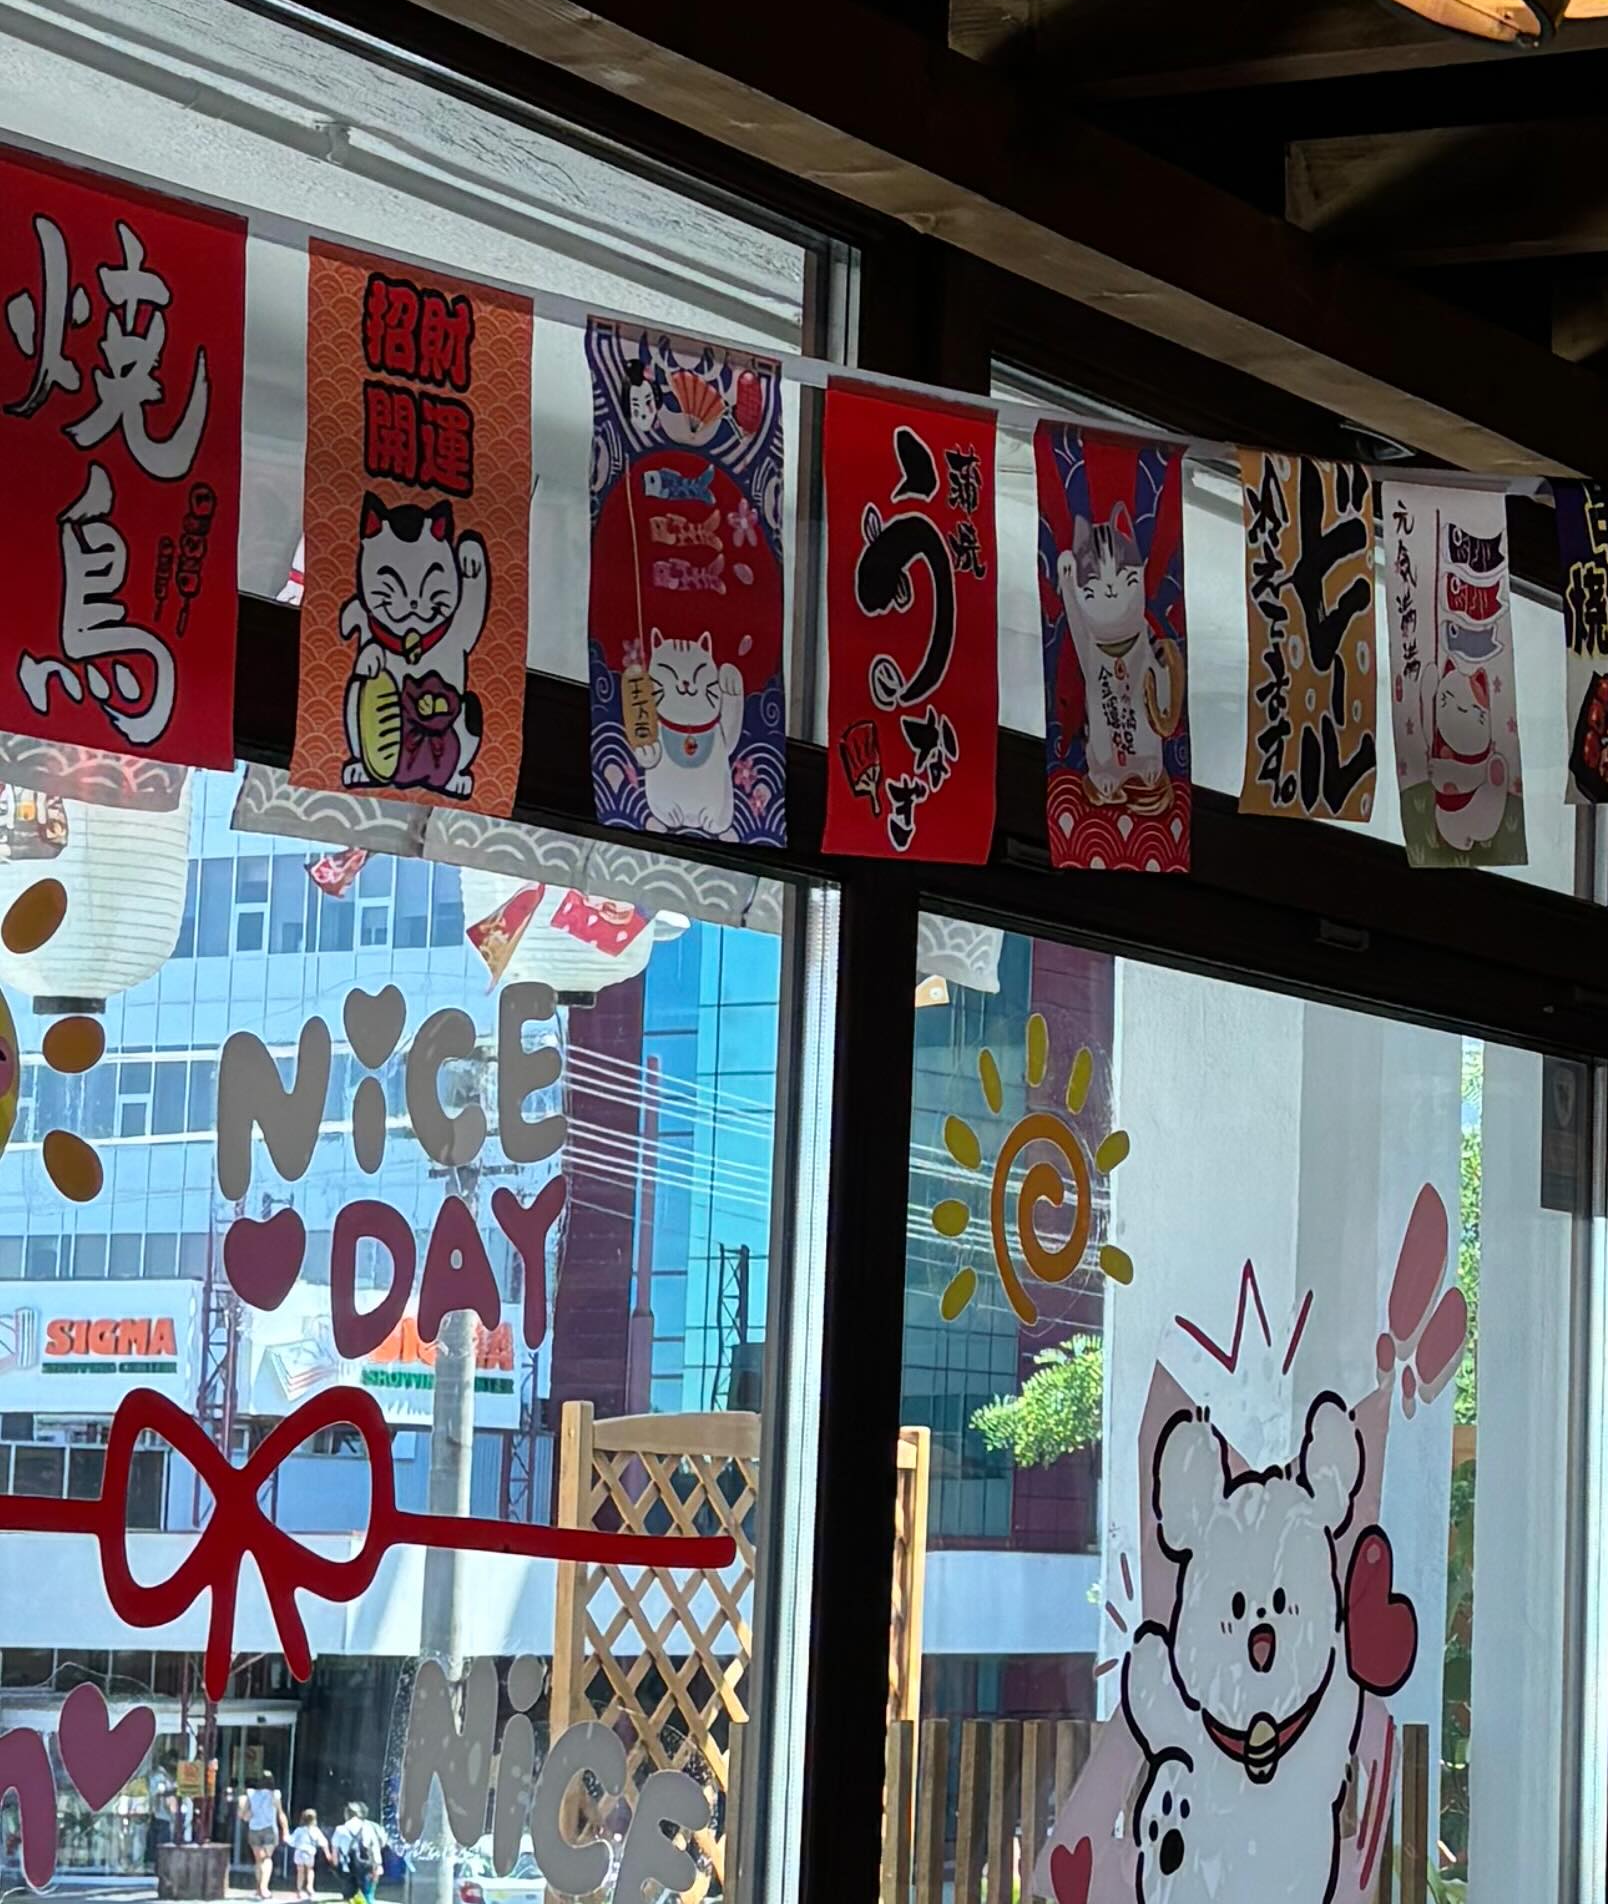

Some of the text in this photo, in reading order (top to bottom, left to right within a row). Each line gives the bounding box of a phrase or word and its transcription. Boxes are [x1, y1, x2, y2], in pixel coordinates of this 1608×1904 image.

[1292, 454, 1376, 816] ビール
[45, 1317, 177, 1356] SIGMA
[329, 1175, 568, 1361] DAY
